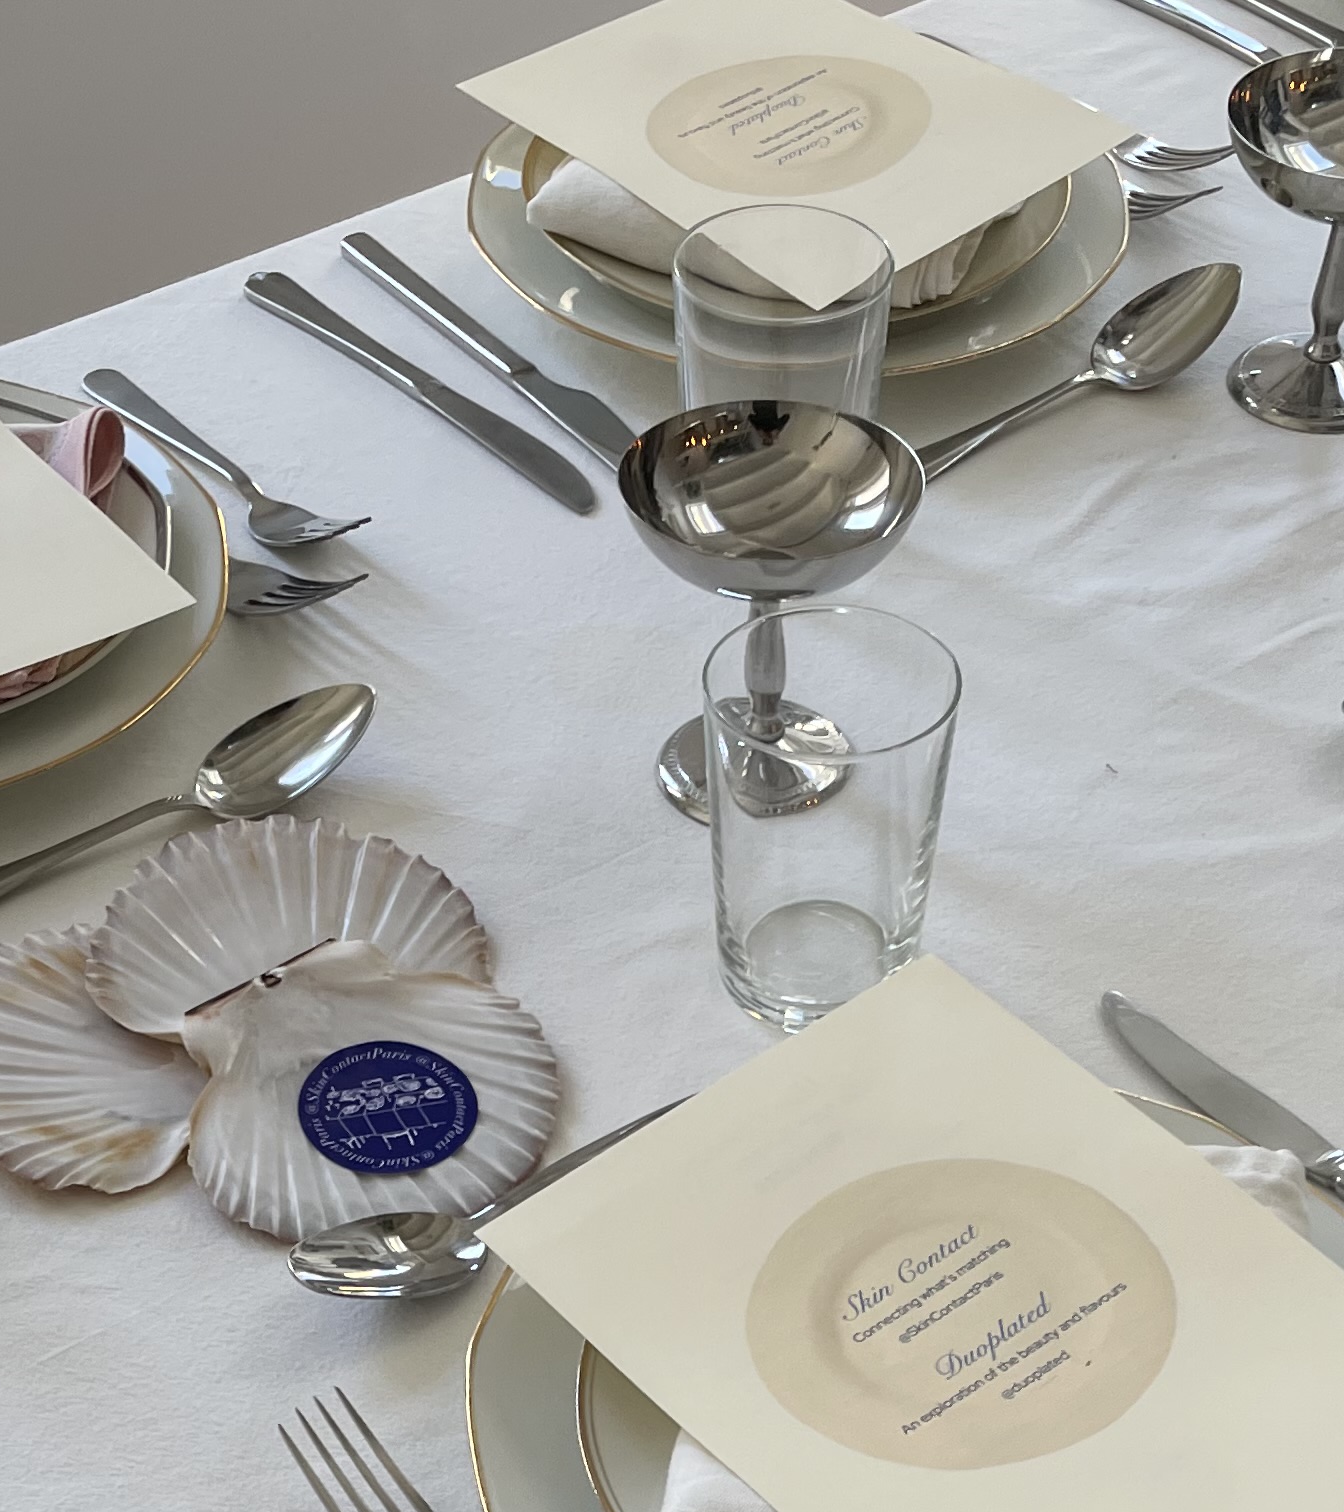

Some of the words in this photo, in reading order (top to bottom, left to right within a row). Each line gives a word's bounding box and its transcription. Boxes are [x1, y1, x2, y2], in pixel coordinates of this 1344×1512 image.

[843, 1284, 894, 1321] Skin
[898, 1224, 978, 1284] Contact
[853, 1298, 922, 1342] Connecting
[919, 1274, 957, 1300] what's
[956, 1238, 1010, 1276] matching
[899, 1271, 1004, 1343] @SkinContactParis
[901, 1420, 921, 1434] An
[920, 1380, 985, 1423] exploration
[984, 1368, 998, 1381] of
[997, 1356, 1019, 1372] the
[1016, 1329, 1059, 1358] beauty
[1059, 1312, 1082, 1331] and
[1079, 1282, 1127, 1315] flavours
[935, 1291, 1051, 1380] Duoplated
[1001, 1349, 1071, 1400] @duoplated
